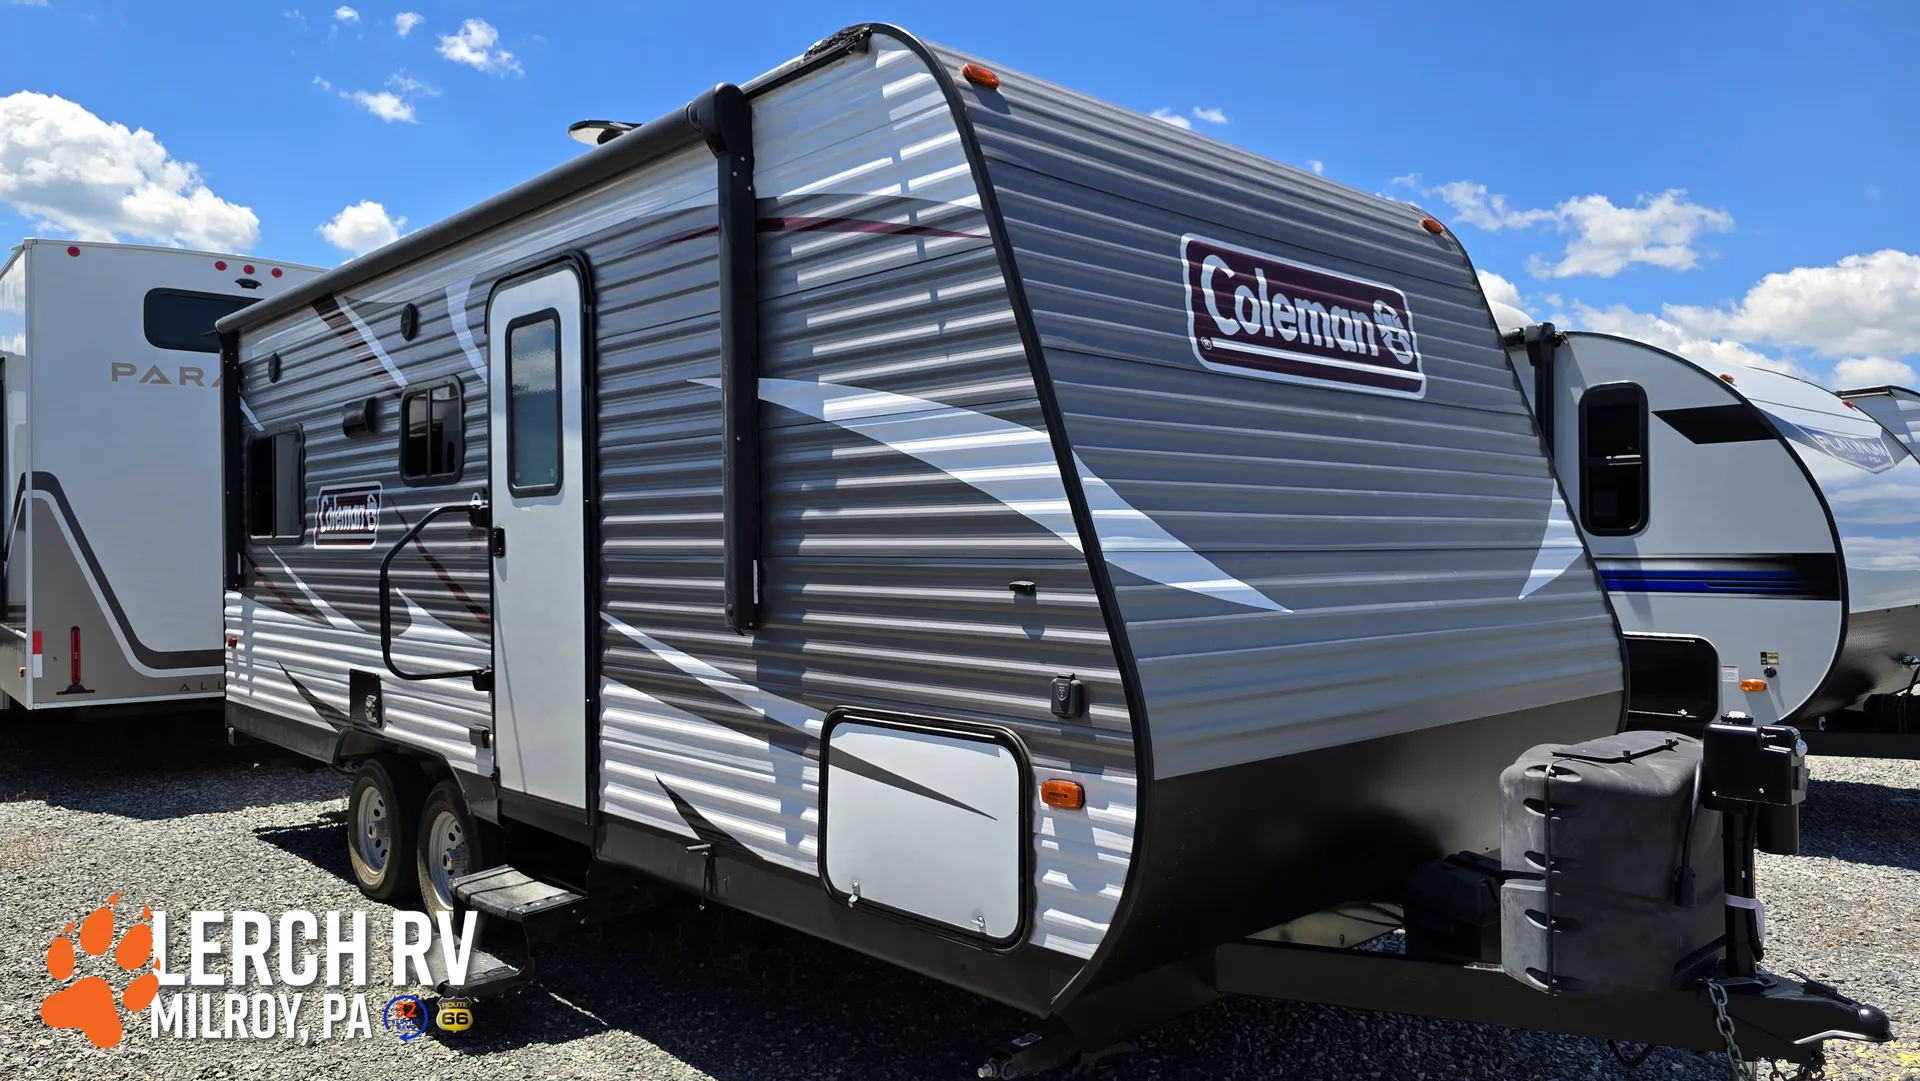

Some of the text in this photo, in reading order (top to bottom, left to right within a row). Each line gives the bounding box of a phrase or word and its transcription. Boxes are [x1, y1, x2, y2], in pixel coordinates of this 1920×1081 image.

[1201, 254, 1379, 357] Coleman
[1812, 433, 1887, 457] PLATINUM
[319, 494, 366, 533] Coleman
